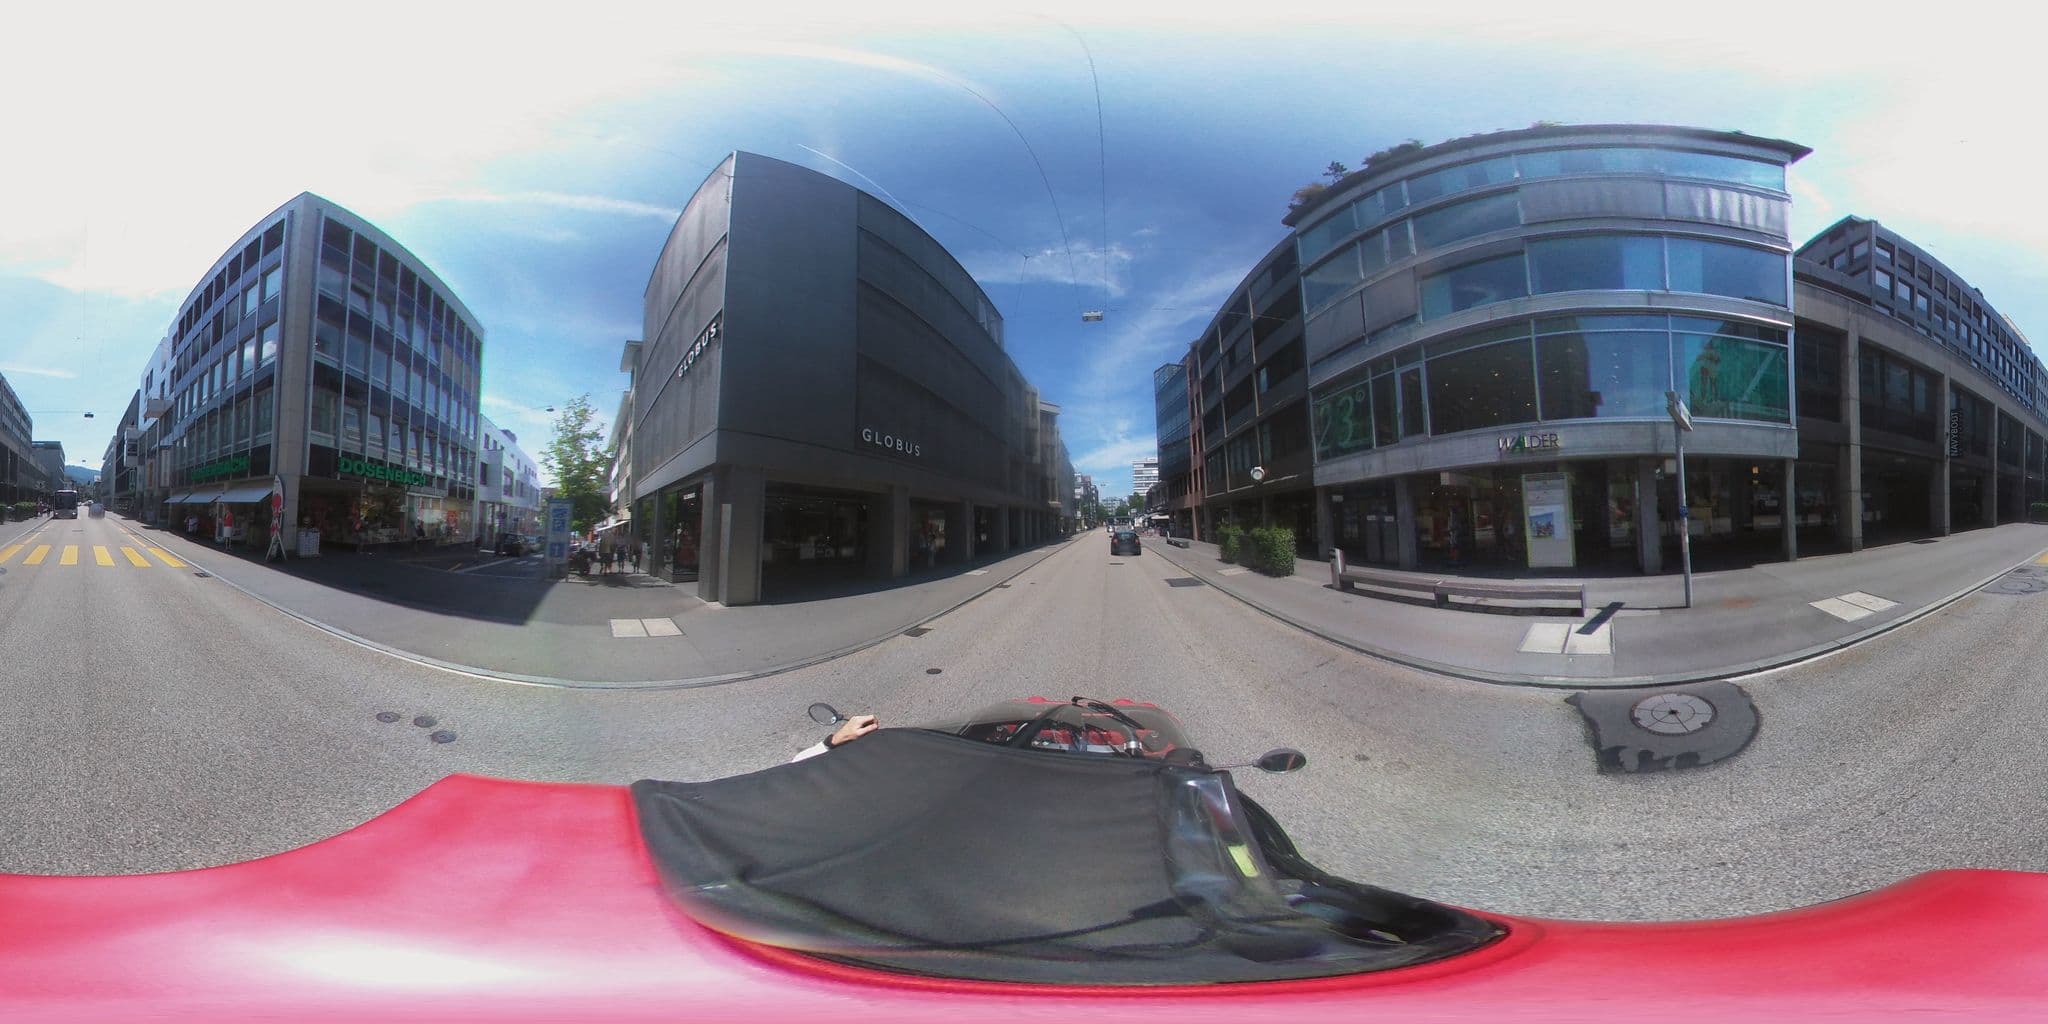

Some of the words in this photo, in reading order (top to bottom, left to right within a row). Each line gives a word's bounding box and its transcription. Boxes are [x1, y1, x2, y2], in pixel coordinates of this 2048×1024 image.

[678, 322, 717, 377] GLOBUS
[862, 428, 920, 457] GLOBUS
[1497, 433, 1560, 450] WALDER
[338, 457, 426, 487] DOSENBACH
